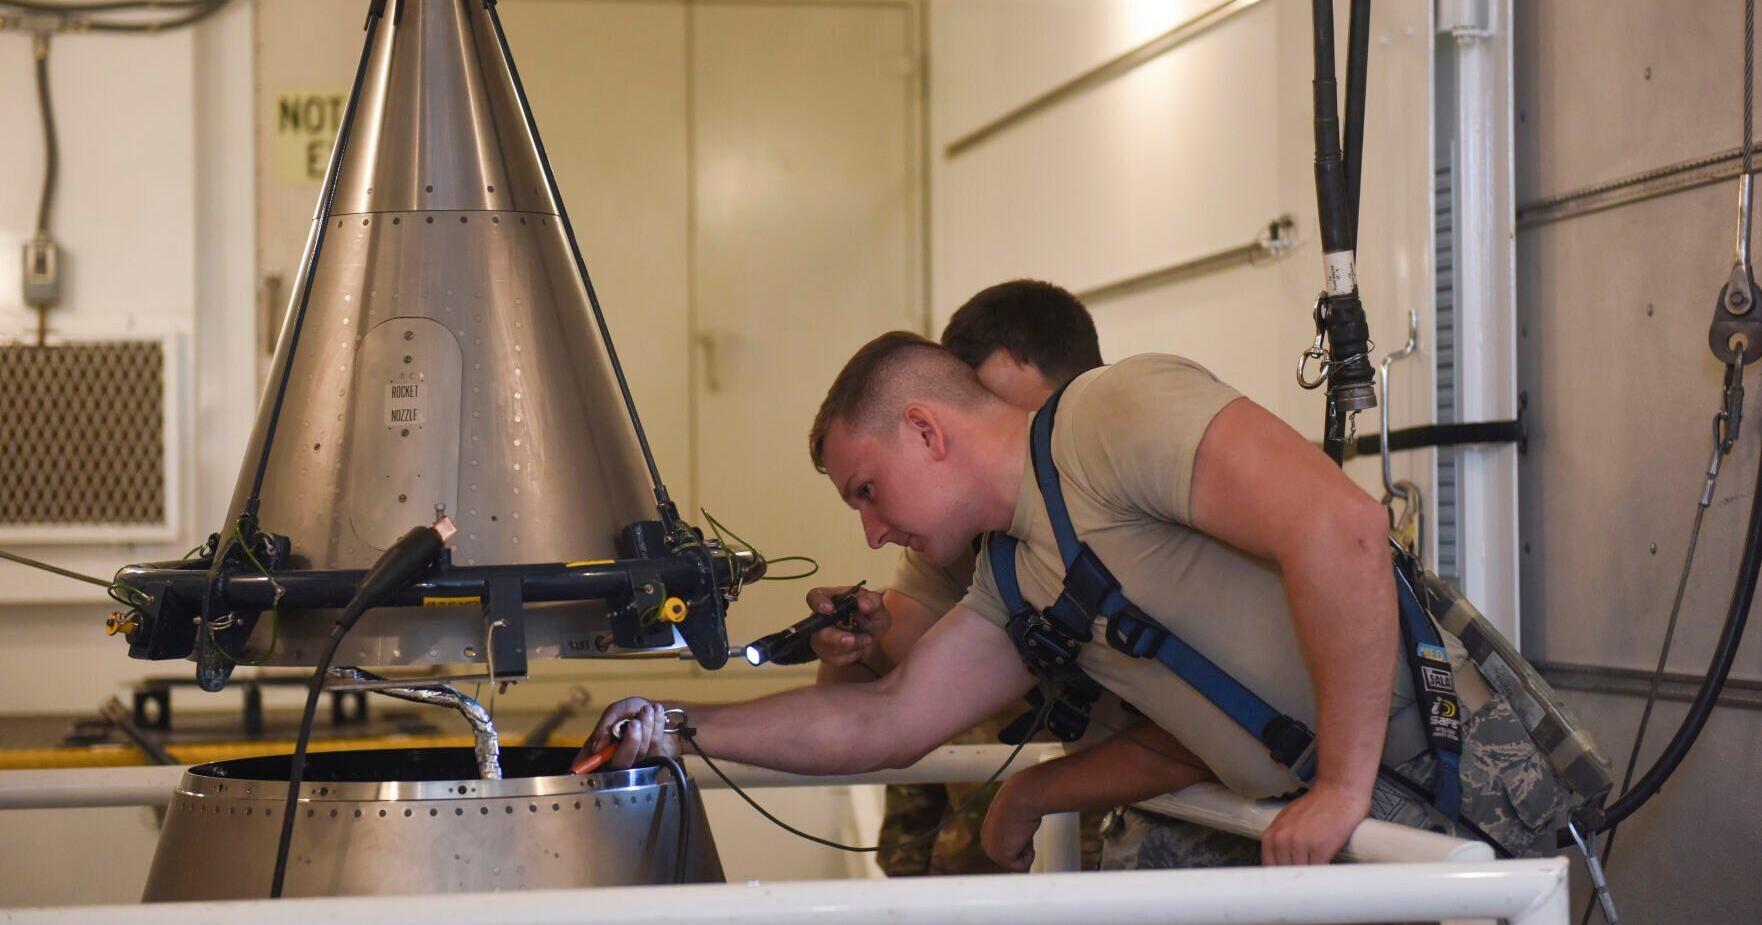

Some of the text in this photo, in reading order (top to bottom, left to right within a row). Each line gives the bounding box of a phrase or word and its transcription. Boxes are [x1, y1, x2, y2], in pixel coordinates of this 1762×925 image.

[279, 96, 344, 133] NOT
[307, 140, 331, 178] E
[391, 384, 419, 398] ROCKET
[391, 408, 419, 421] NOZZLE
